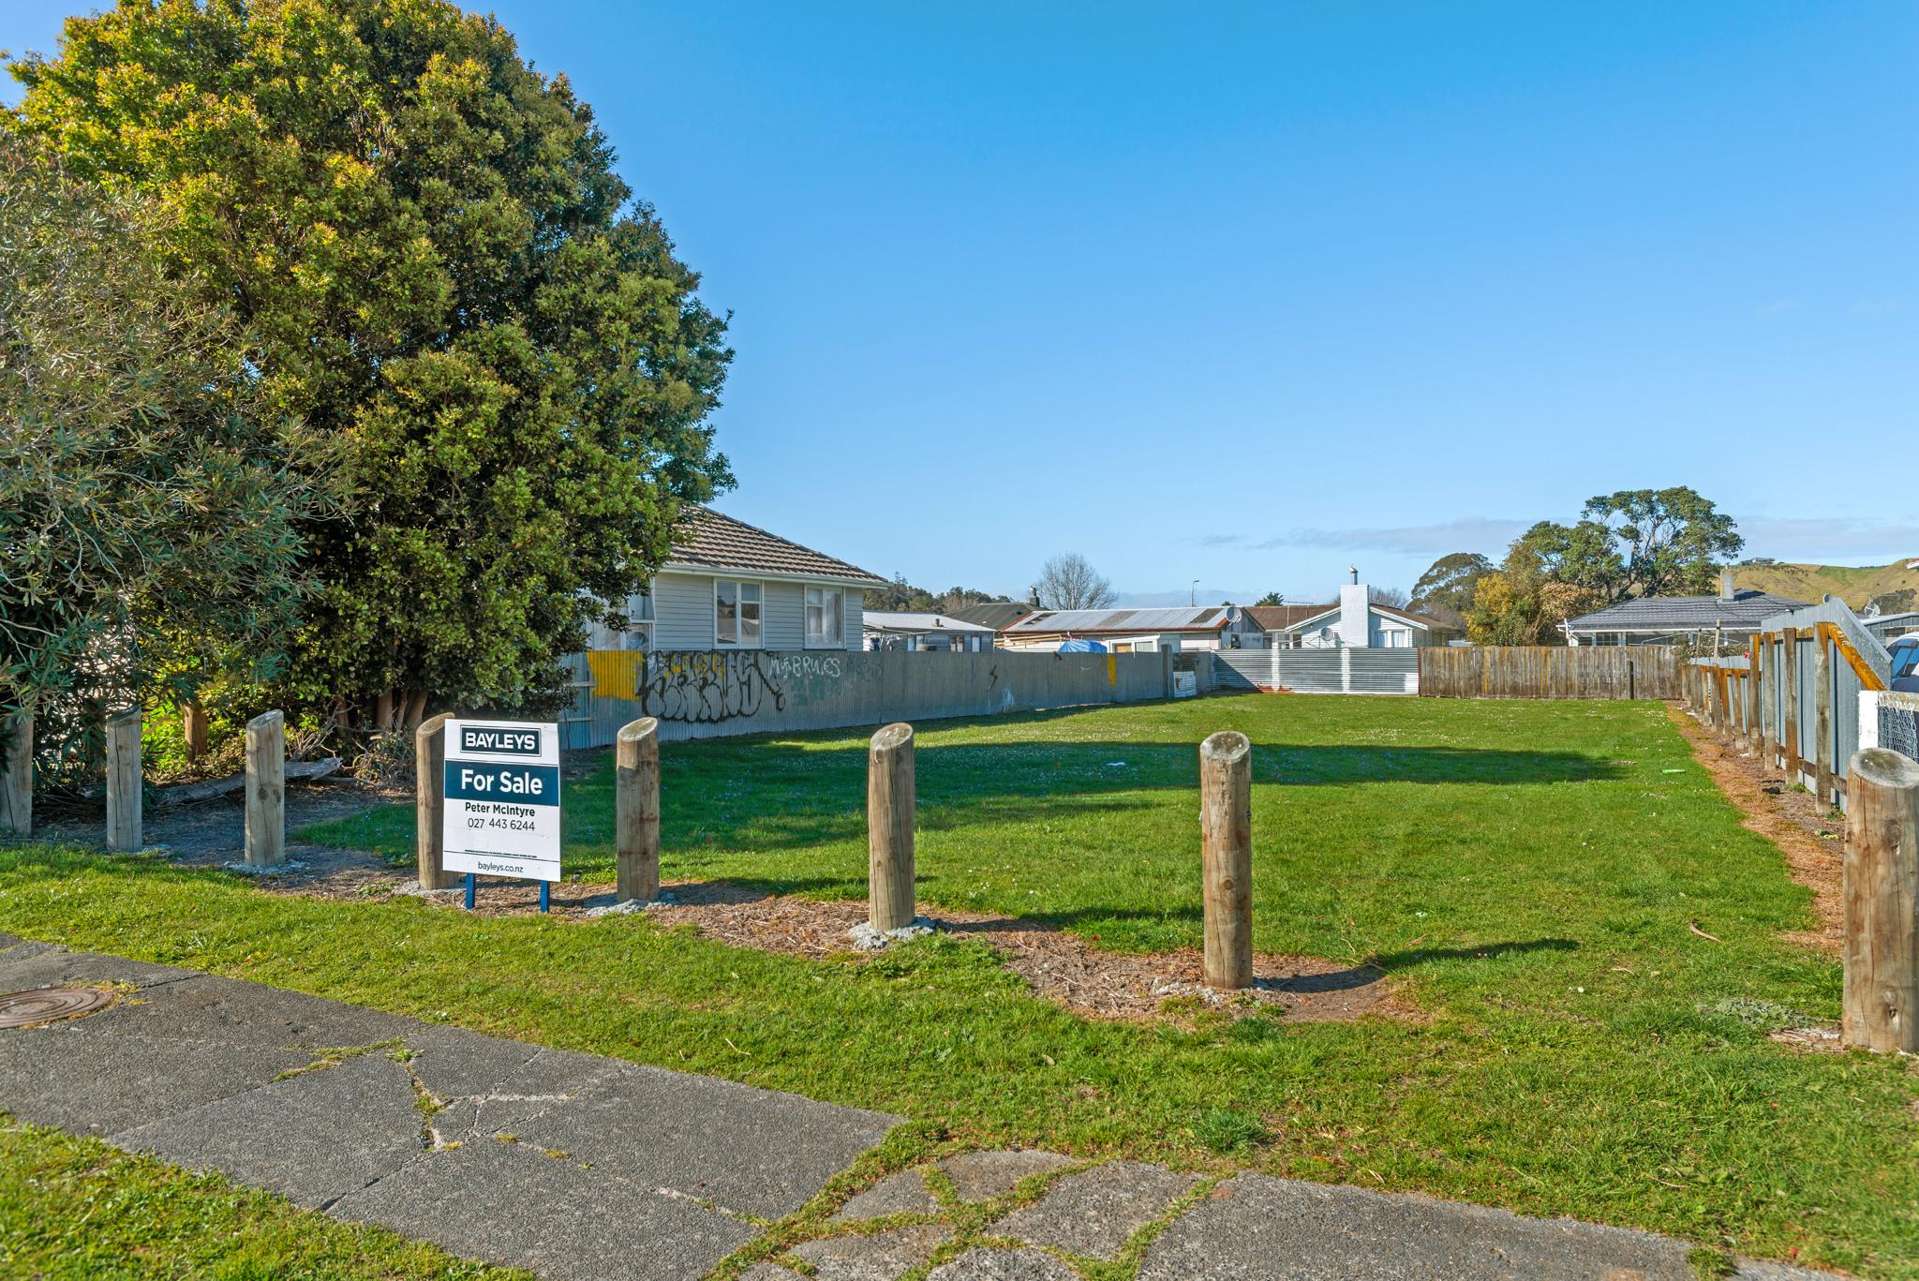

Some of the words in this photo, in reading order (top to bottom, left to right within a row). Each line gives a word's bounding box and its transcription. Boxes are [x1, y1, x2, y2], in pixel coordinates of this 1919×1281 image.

[465, 732, 536, 750] BAYLEYS
[461, 768, 495, 792] For
[499, 770, 543, 795] Sale
[465, 801, 491, 815] Peter
[493, 804, 536, 818] McIntyre
[467, 817, 485, 829] 027
[488, 818, 508, 830] 443
[510, 819, 535, 831] 6244
[478, 861, 524, 873] bayleys.co.nz
